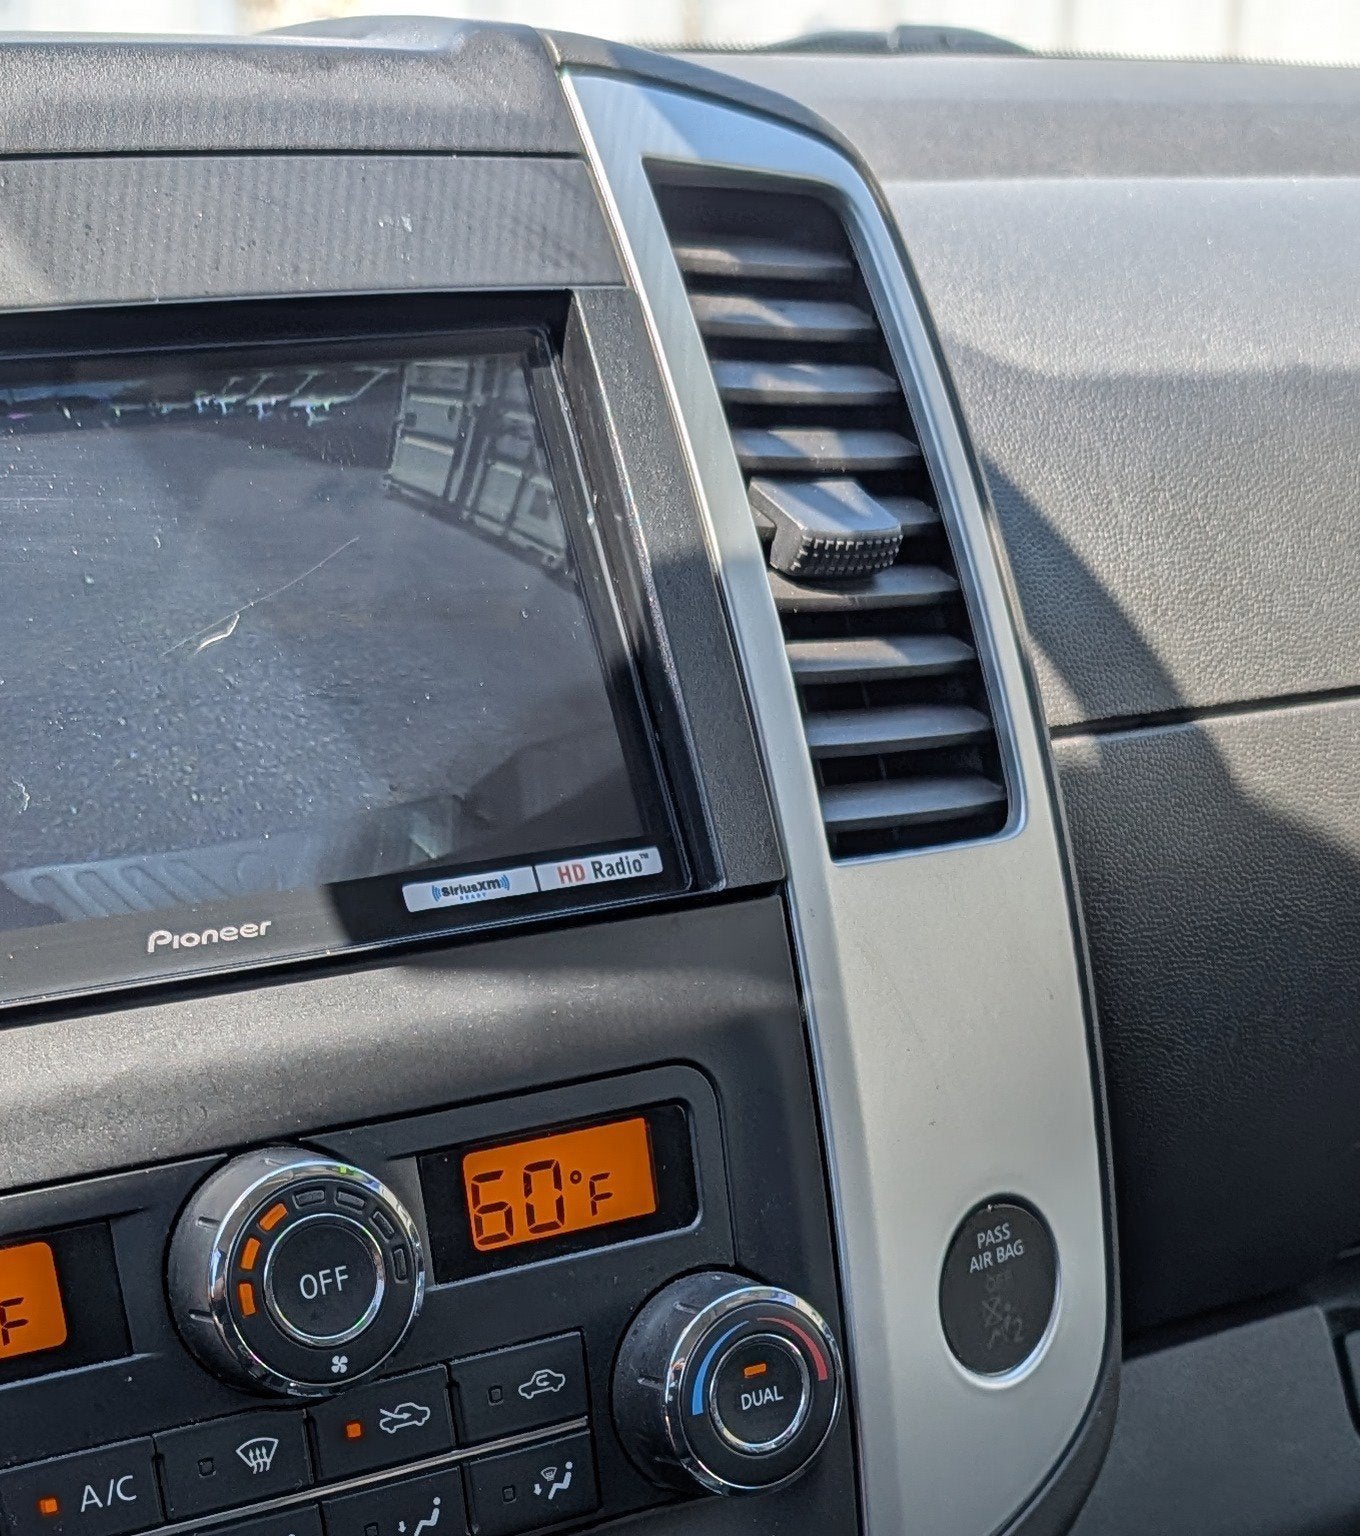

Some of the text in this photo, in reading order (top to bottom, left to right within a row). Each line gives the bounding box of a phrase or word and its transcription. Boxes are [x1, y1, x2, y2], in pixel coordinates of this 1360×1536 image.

[556, 861, 587, 885] HD
[146, 920, 272, 954] Pioneer
[976, 1222, 1011, 1250] PASS
[968, 1238, 1025, 1274] AIR BAG
[298, 1265, 351, 1300] OFF
[739, 1385, 785, 1411] DUAL
[79, 1474, 139, 1514] A/C
